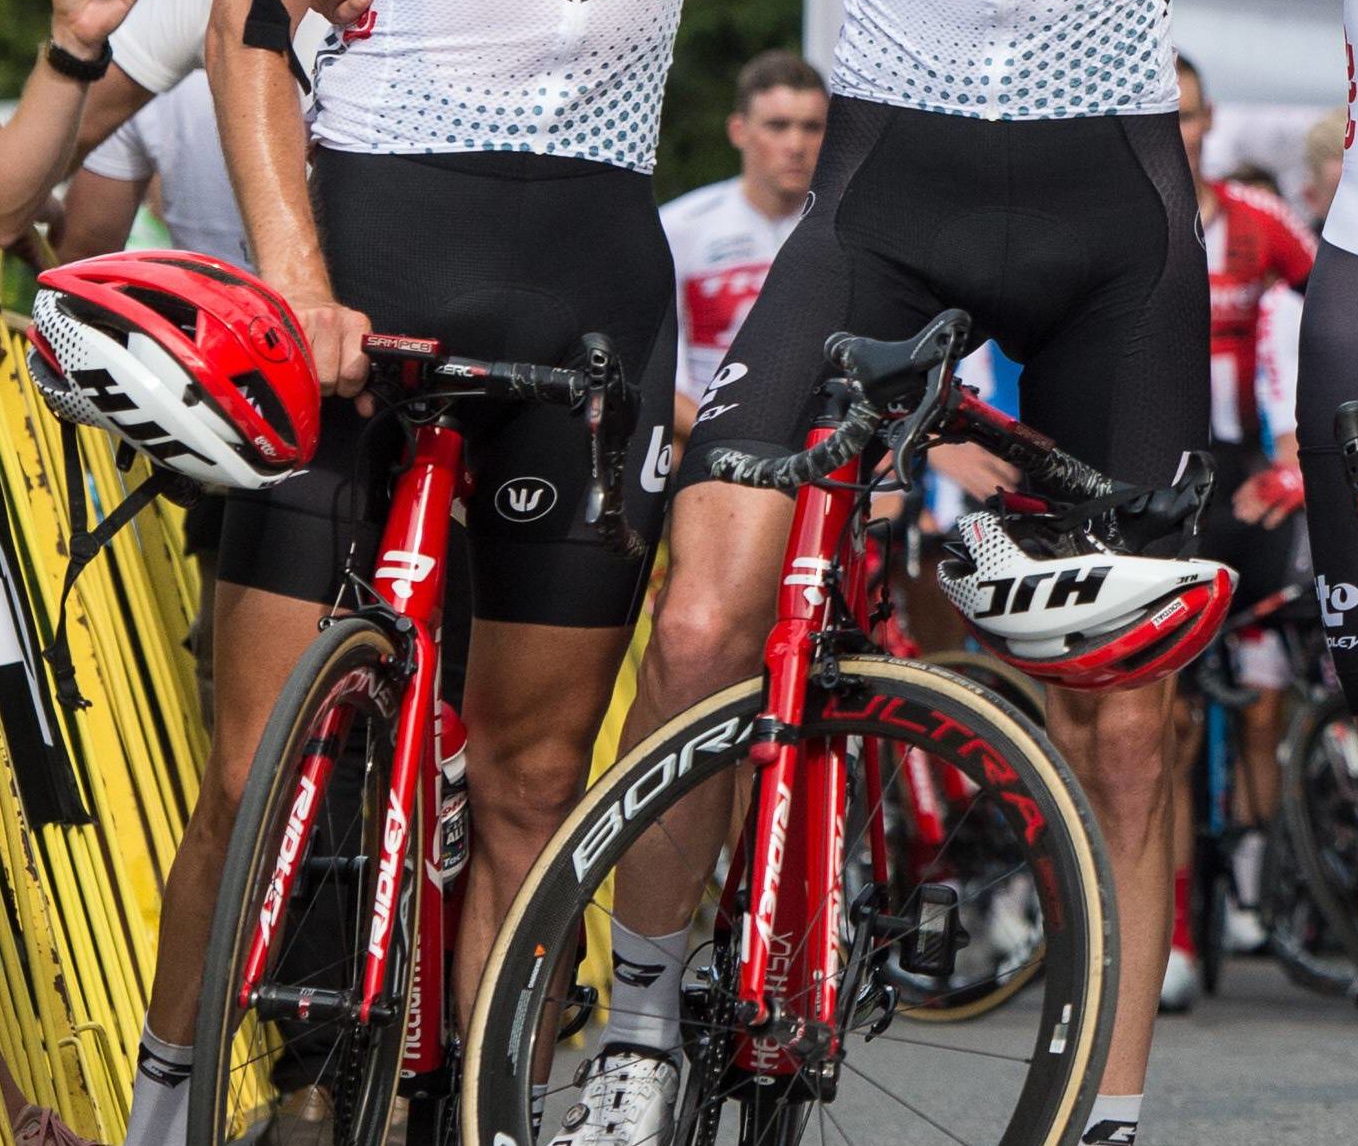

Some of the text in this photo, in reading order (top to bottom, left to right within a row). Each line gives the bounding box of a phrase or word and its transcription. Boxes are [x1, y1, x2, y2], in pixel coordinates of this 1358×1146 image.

[572, 714, 756, 883] BOR
[823, 694, 1045, 845] ULTRA
[367, 787, 407, 960] RIDLEY
[755, 780, 792, 952] RIDLEY
